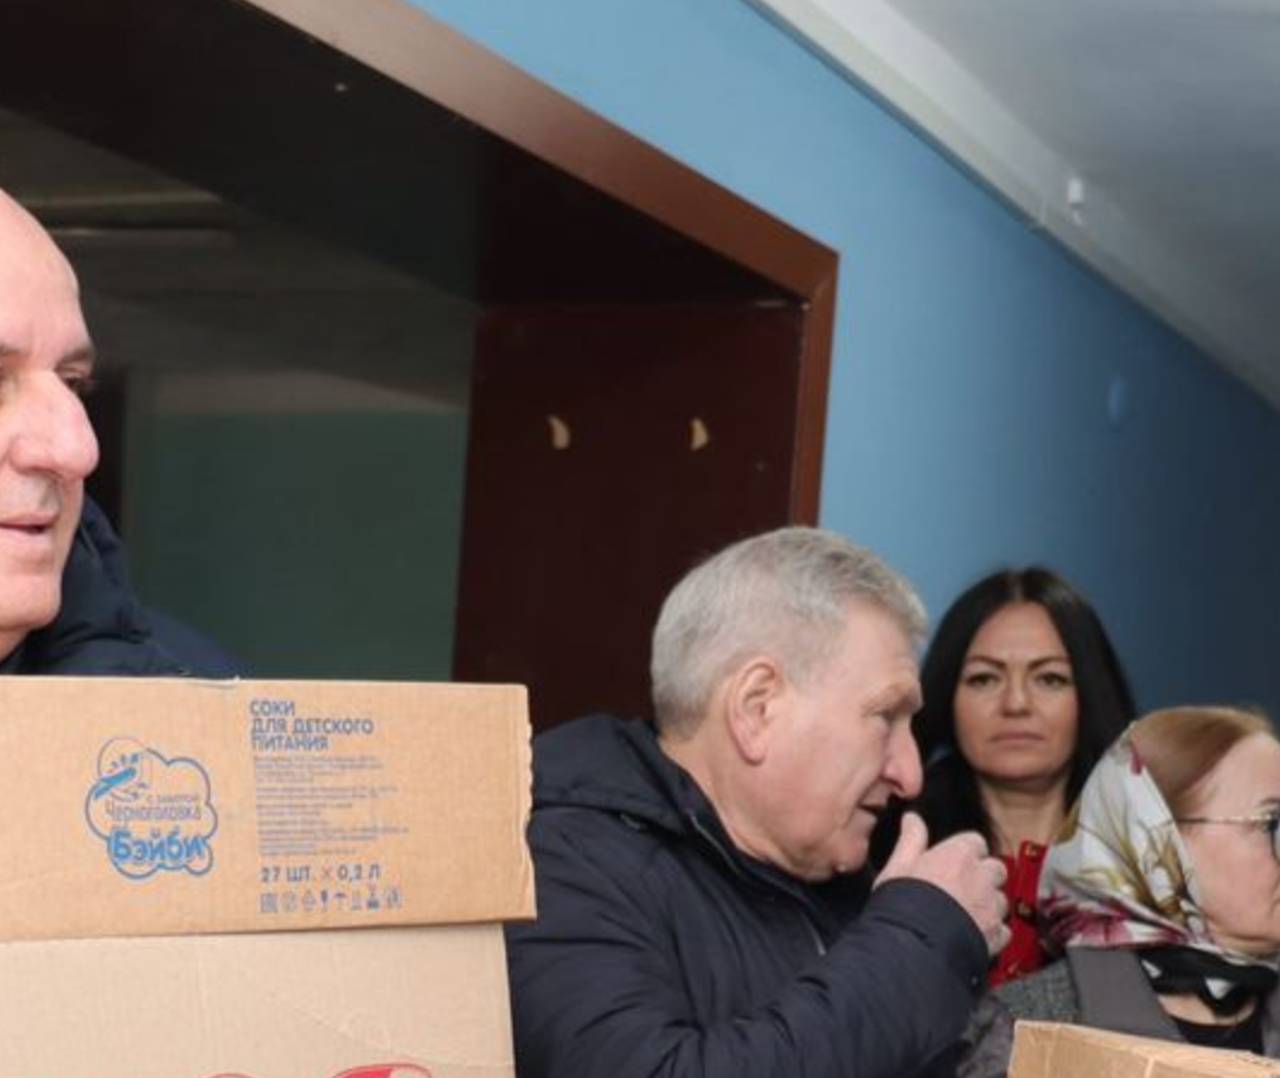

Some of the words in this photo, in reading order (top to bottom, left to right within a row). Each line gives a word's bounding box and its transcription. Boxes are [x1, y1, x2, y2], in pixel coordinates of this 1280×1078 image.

[250, 700, 295, 716] СОКИ
[252, 718, 287, 734] ДЛЯ
[293, 718, 374, 735] ДЕТСКОГО
[251, 735, 329, 750] ПИТАНИЯ
[261, 867, 281, 882] 27
[337, 865, 363, 883] 0,2
